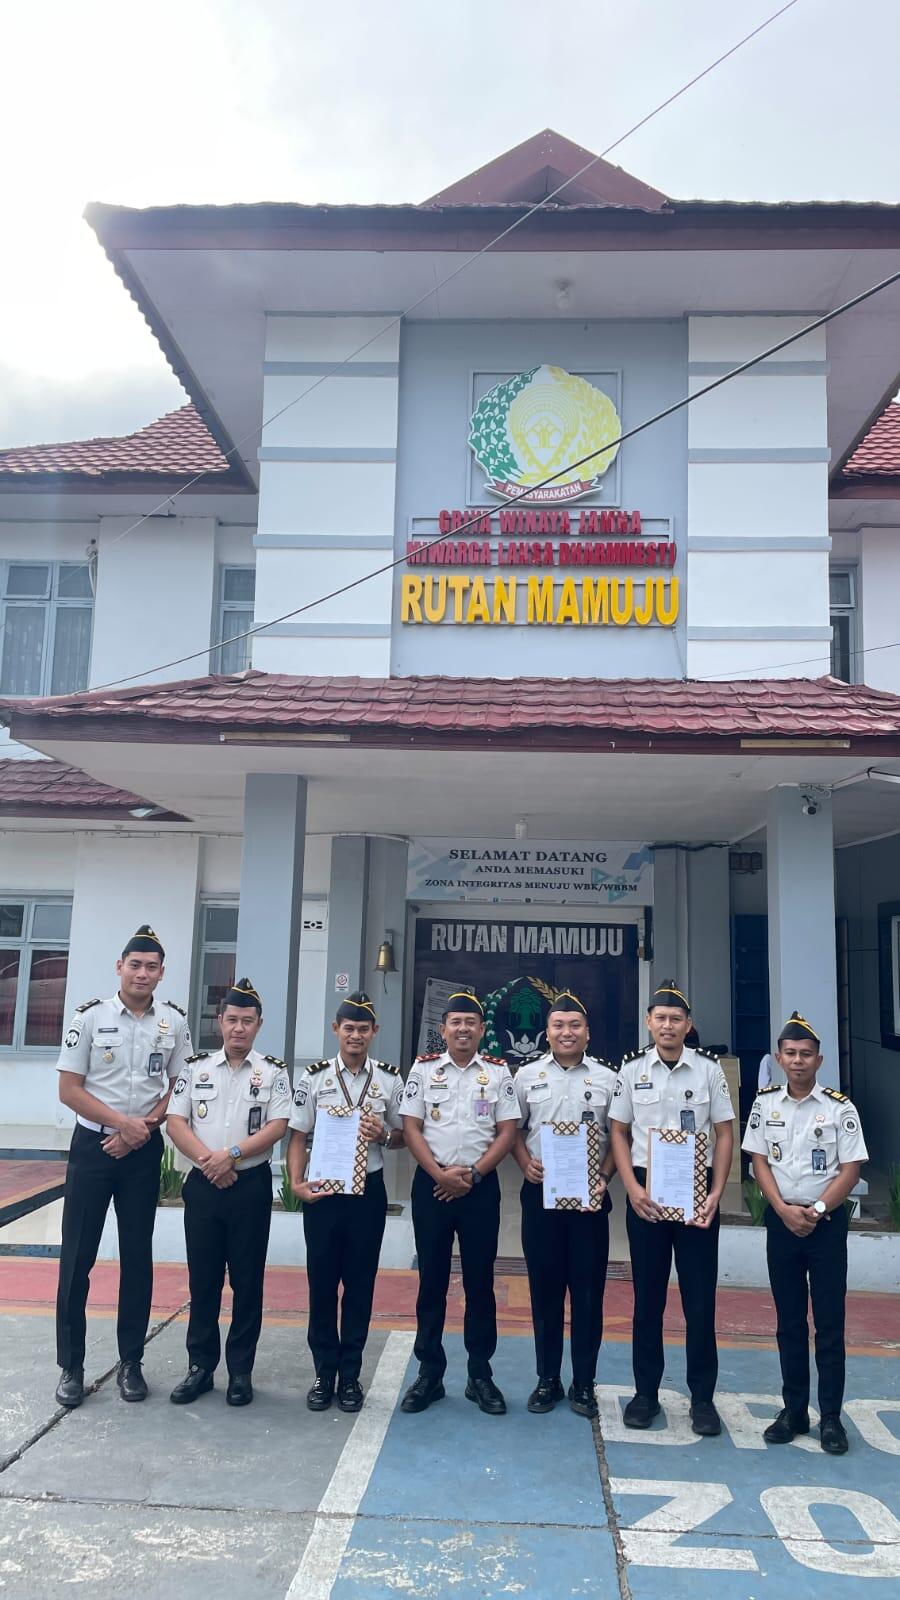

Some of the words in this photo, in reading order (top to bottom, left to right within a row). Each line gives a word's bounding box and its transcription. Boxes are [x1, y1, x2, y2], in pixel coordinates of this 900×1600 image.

[438, 510, 492, 534] GRIYA
[499, 511, 571, 534] WINAYA
[406, 541, 492, 566] MIWARGA
[498, 542, 554, 566] LAKSA
[400, 575, 517, 624] RUTAN
[527, 576, 680, 625] MAMUJU
[449, 849, 531, 861] SELAMAT
[536, 851, 608, 863] DATANG
[475, 865, 511, 873] ANDA
[514, 867, 584, 876] MEMASUKI
[425, 879, 455, 887] ZONA
[457, 880, 522, 889] INTEGRITAS
[525, 882, 570, 891] MENUJU
[573, 883, 638, 892] WBK/WBBM
[431, 923, 507, 953] RUTAN
[513, 925, 624, 956] MAMUJU
